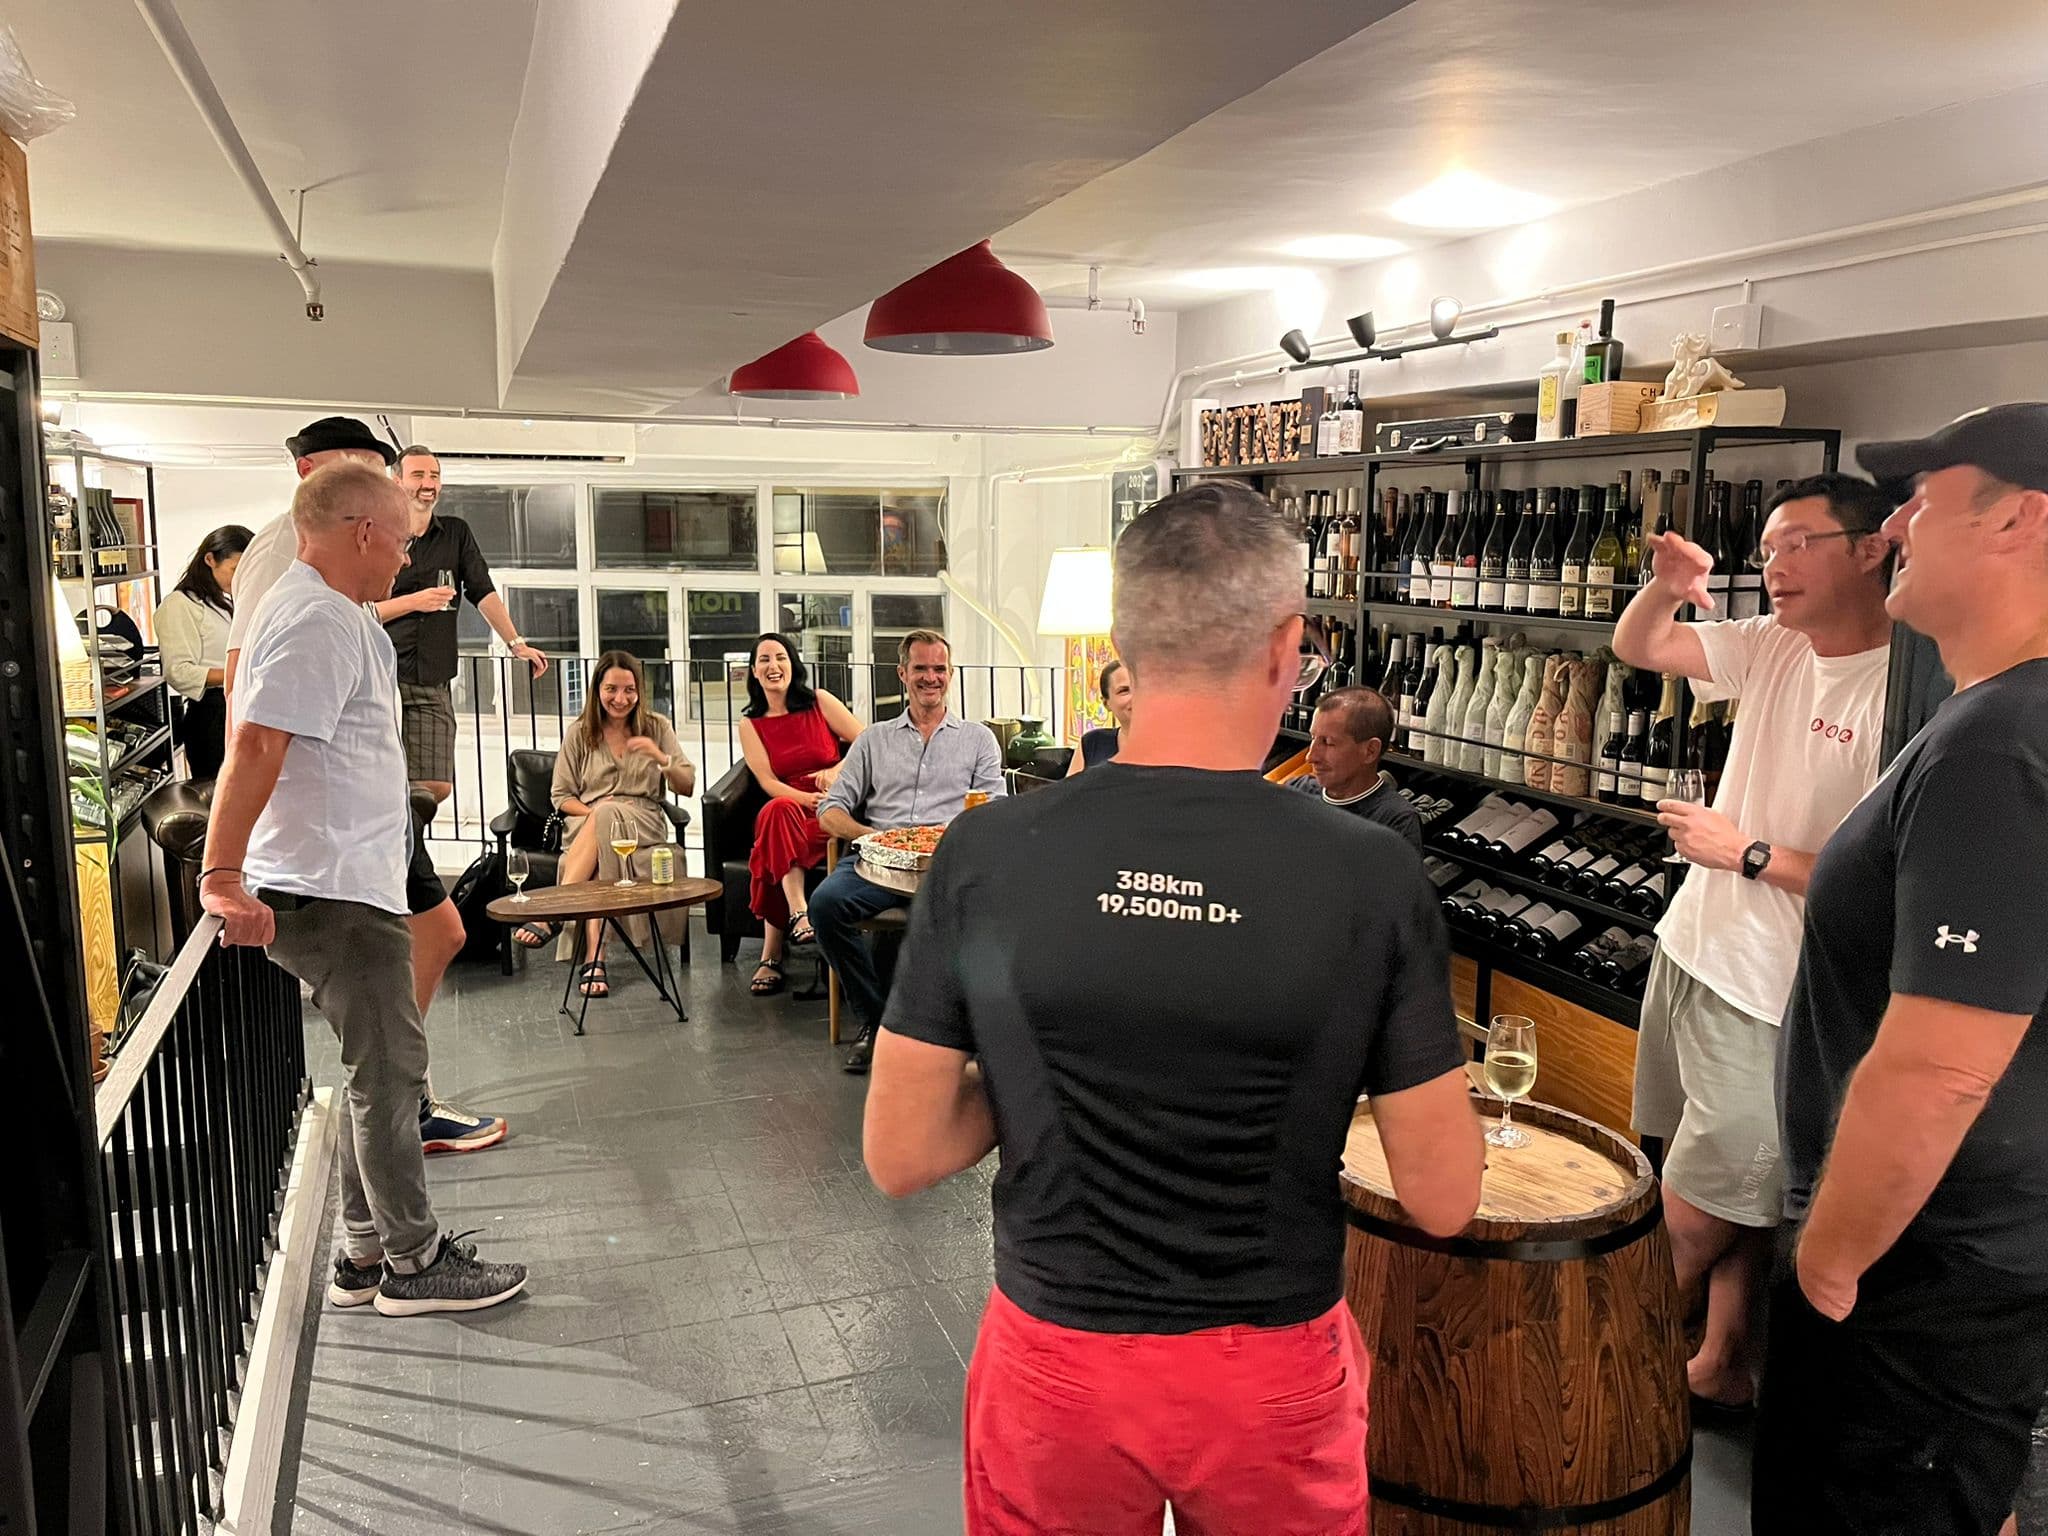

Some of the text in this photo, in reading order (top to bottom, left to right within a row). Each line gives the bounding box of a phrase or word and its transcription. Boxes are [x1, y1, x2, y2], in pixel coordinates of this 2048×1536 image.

[1201, 398, 1301, 467] WINE
[1116, 870, 1203, 897] 388km
[1097, 893, 1243, 924] 19,500m D+
